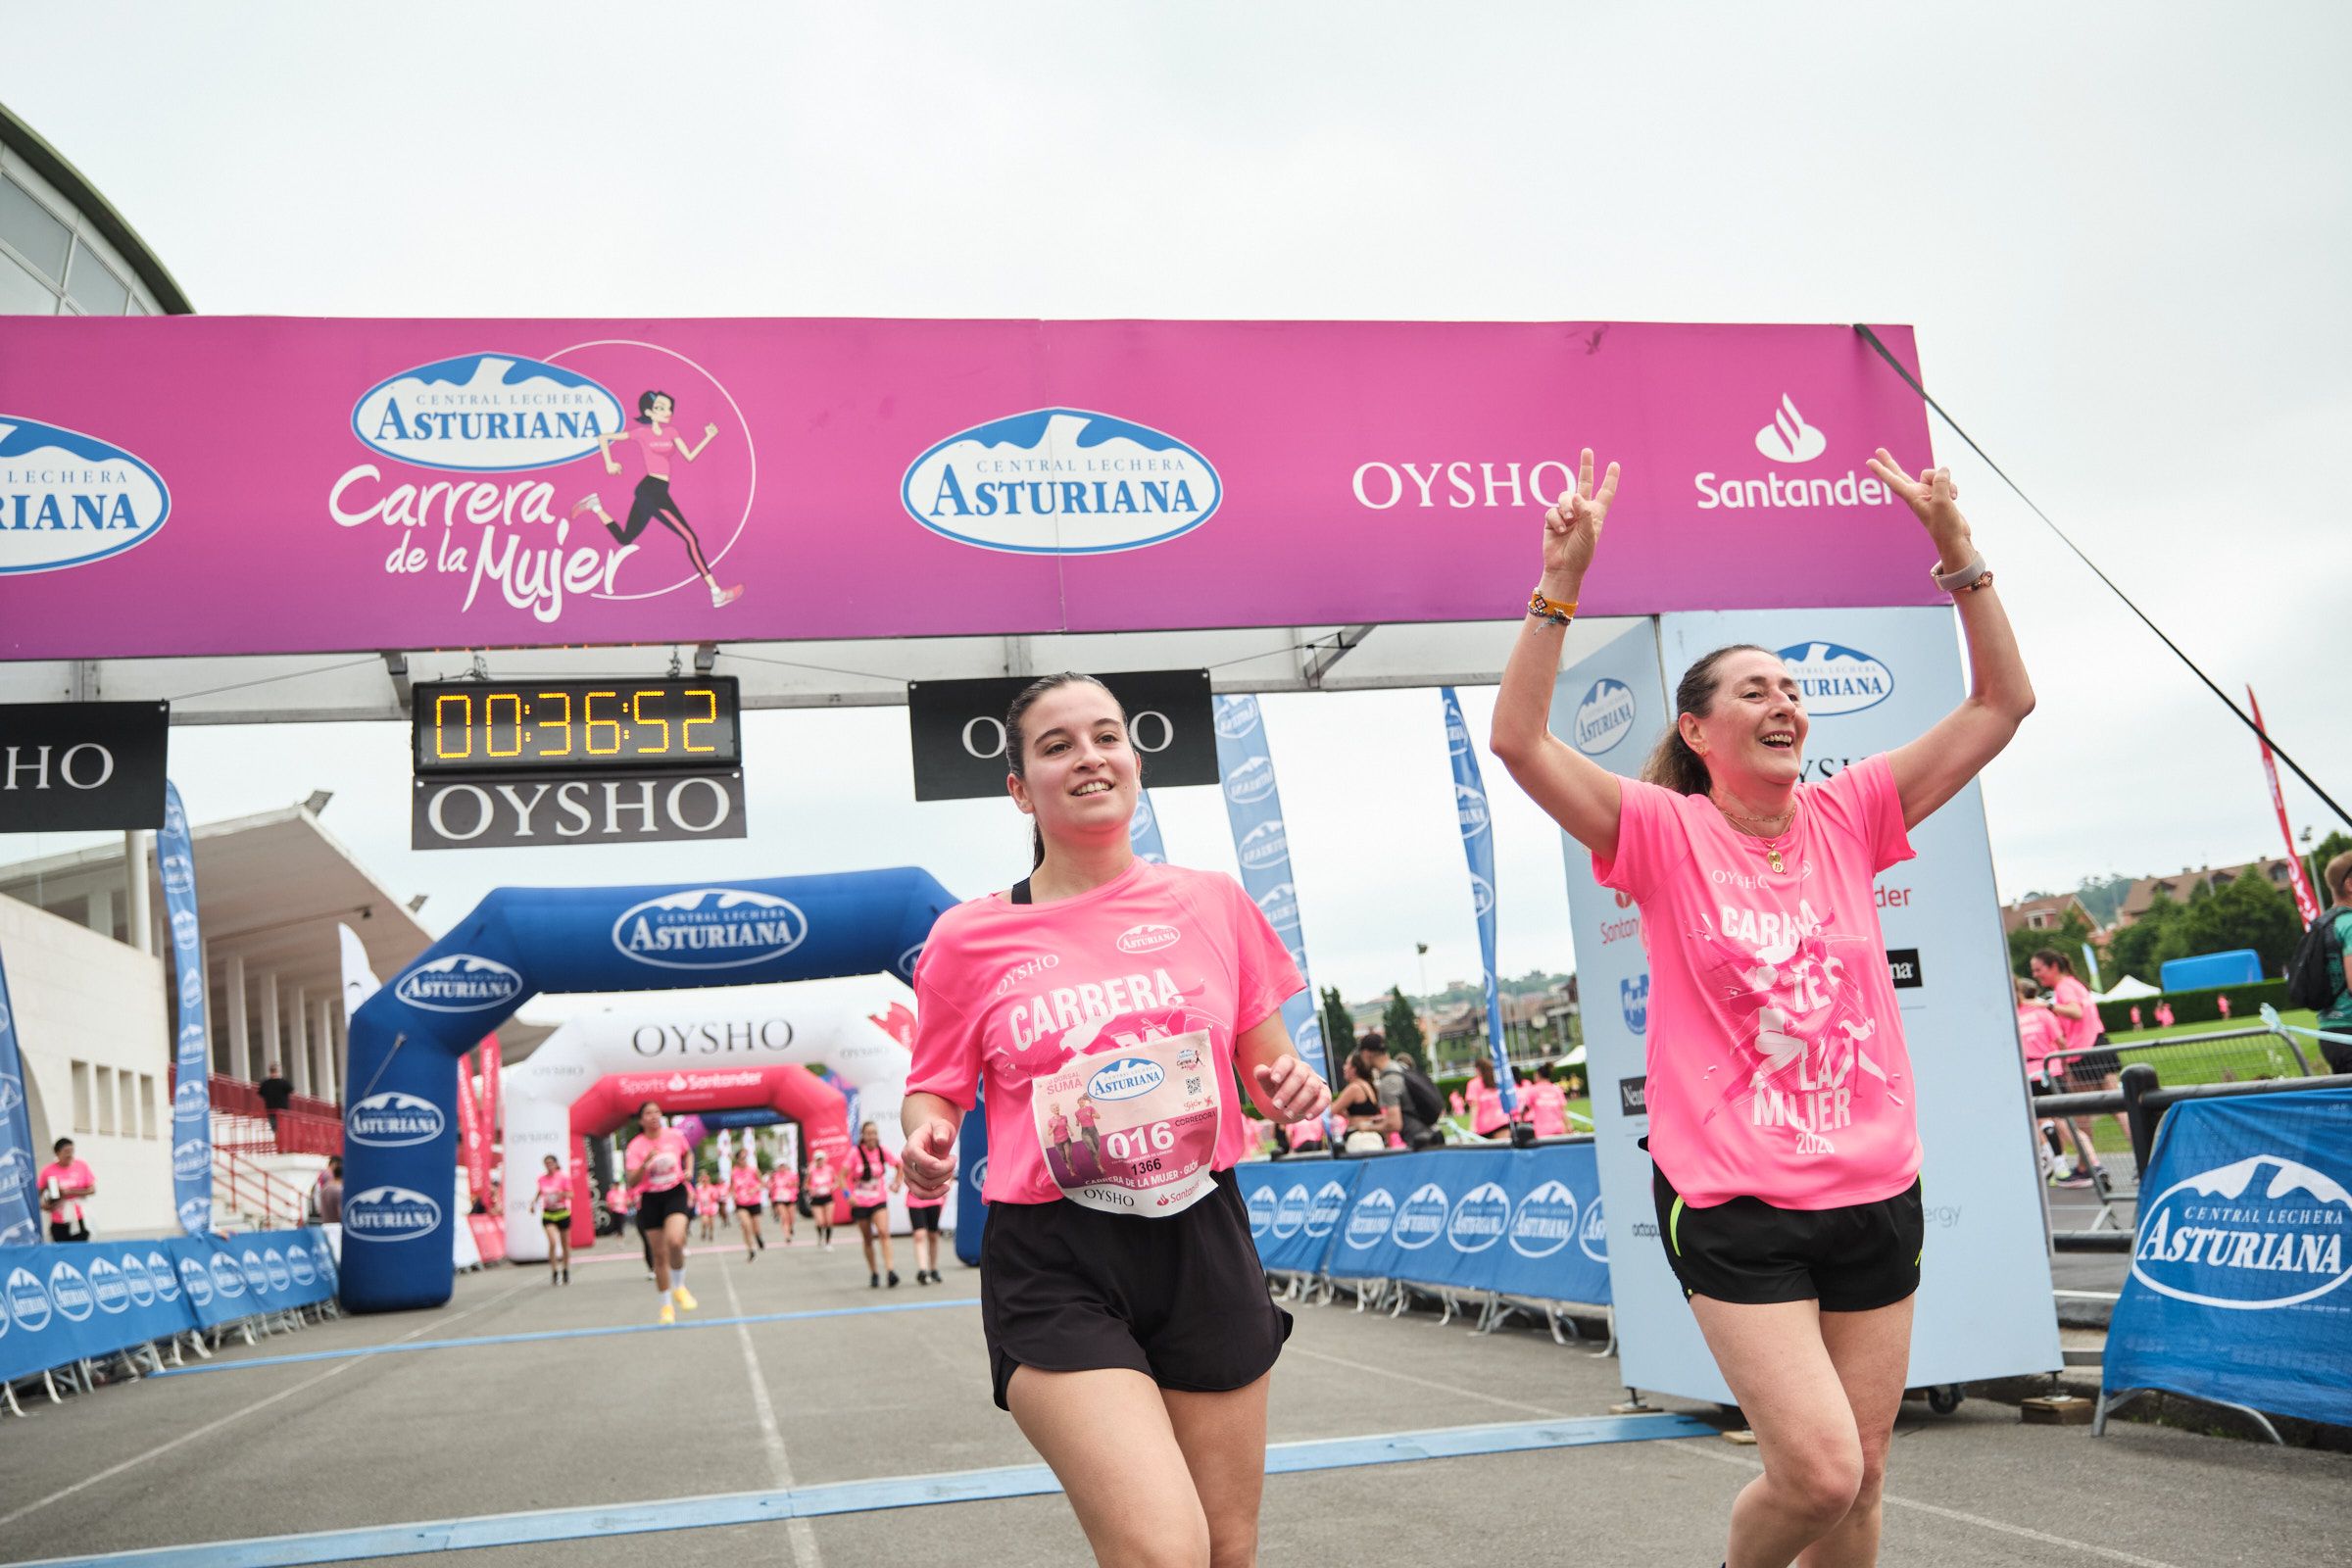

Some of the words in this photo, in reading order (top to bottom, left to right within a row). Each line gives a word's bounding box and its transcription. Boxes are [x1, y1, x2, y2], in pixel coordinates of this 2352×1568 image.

[416, 393, 503, 406] CENTRAL
[510, 392, 595, 406] LECHERA
[373, 396, 602, 440] ASTURIANA
[7, 470, 127, 484] LECHERA
[976, 459, 1076, 473] CENTRAL
[1087, 458, 1186, 472] LECHERA
[328, 463, 557, 527] Carrera
[929, 463, 1200, 516] ASTURIANA
[1351, 461, 1577, 510] OYSHO
[0, 493, 141, 530] IANA
[385, 529, 428, 574] de
[437, 526, 468, 573] la
[462, 517, 641, 624] Mujer
[1802, 675, 1884, 697] URIANA
[435, 689, 717, 760] 00:36:52
[1579, 701, 1633, 746] ASTURIANA
[428, 777, 730, 841] OYSHO
[657, 912, 718, 924] CENTRAL
[628, 915, 794, 951] ASTURIANA
[1120, 932, 1176, 951] ASTURIANA
[996, 954, 1059, 996] OYSHO
[404, 977, 513, 999] ASTURIANA
[1009, 967, 1184, 1053] CARRERA
[632, 1018, 794, 1057] OYSHO
[618, 1077, 666, 1096] Sports
[688, 1071, 762, 1090] Santander
[1047, 1078, 1083, 1095] SUMA
[1095, 1071, 1160, 1096] ASTURIANA
[352, 1112, 438, 1134] ASTURIANA
[1106, 1120, 1175, 1159] 016
[1125, 1177, 1136, 1187] DE
[1138, 1177, 1150, 1188] LA
[1151, 1169, 1179, 1185] MUJER
[1131, 1158, 1162, 1175] 1366
[1084, 1189, 1135, 1207] OYSHO
[348, 1206, 434, 1228] ASTURIANA
[2184, 1205, 2260, 1223] CENTRAL
[2267, 1208, 2343, 1225] LECHERA
[2136, 1206, 2341, 1275] ASTURIANA
